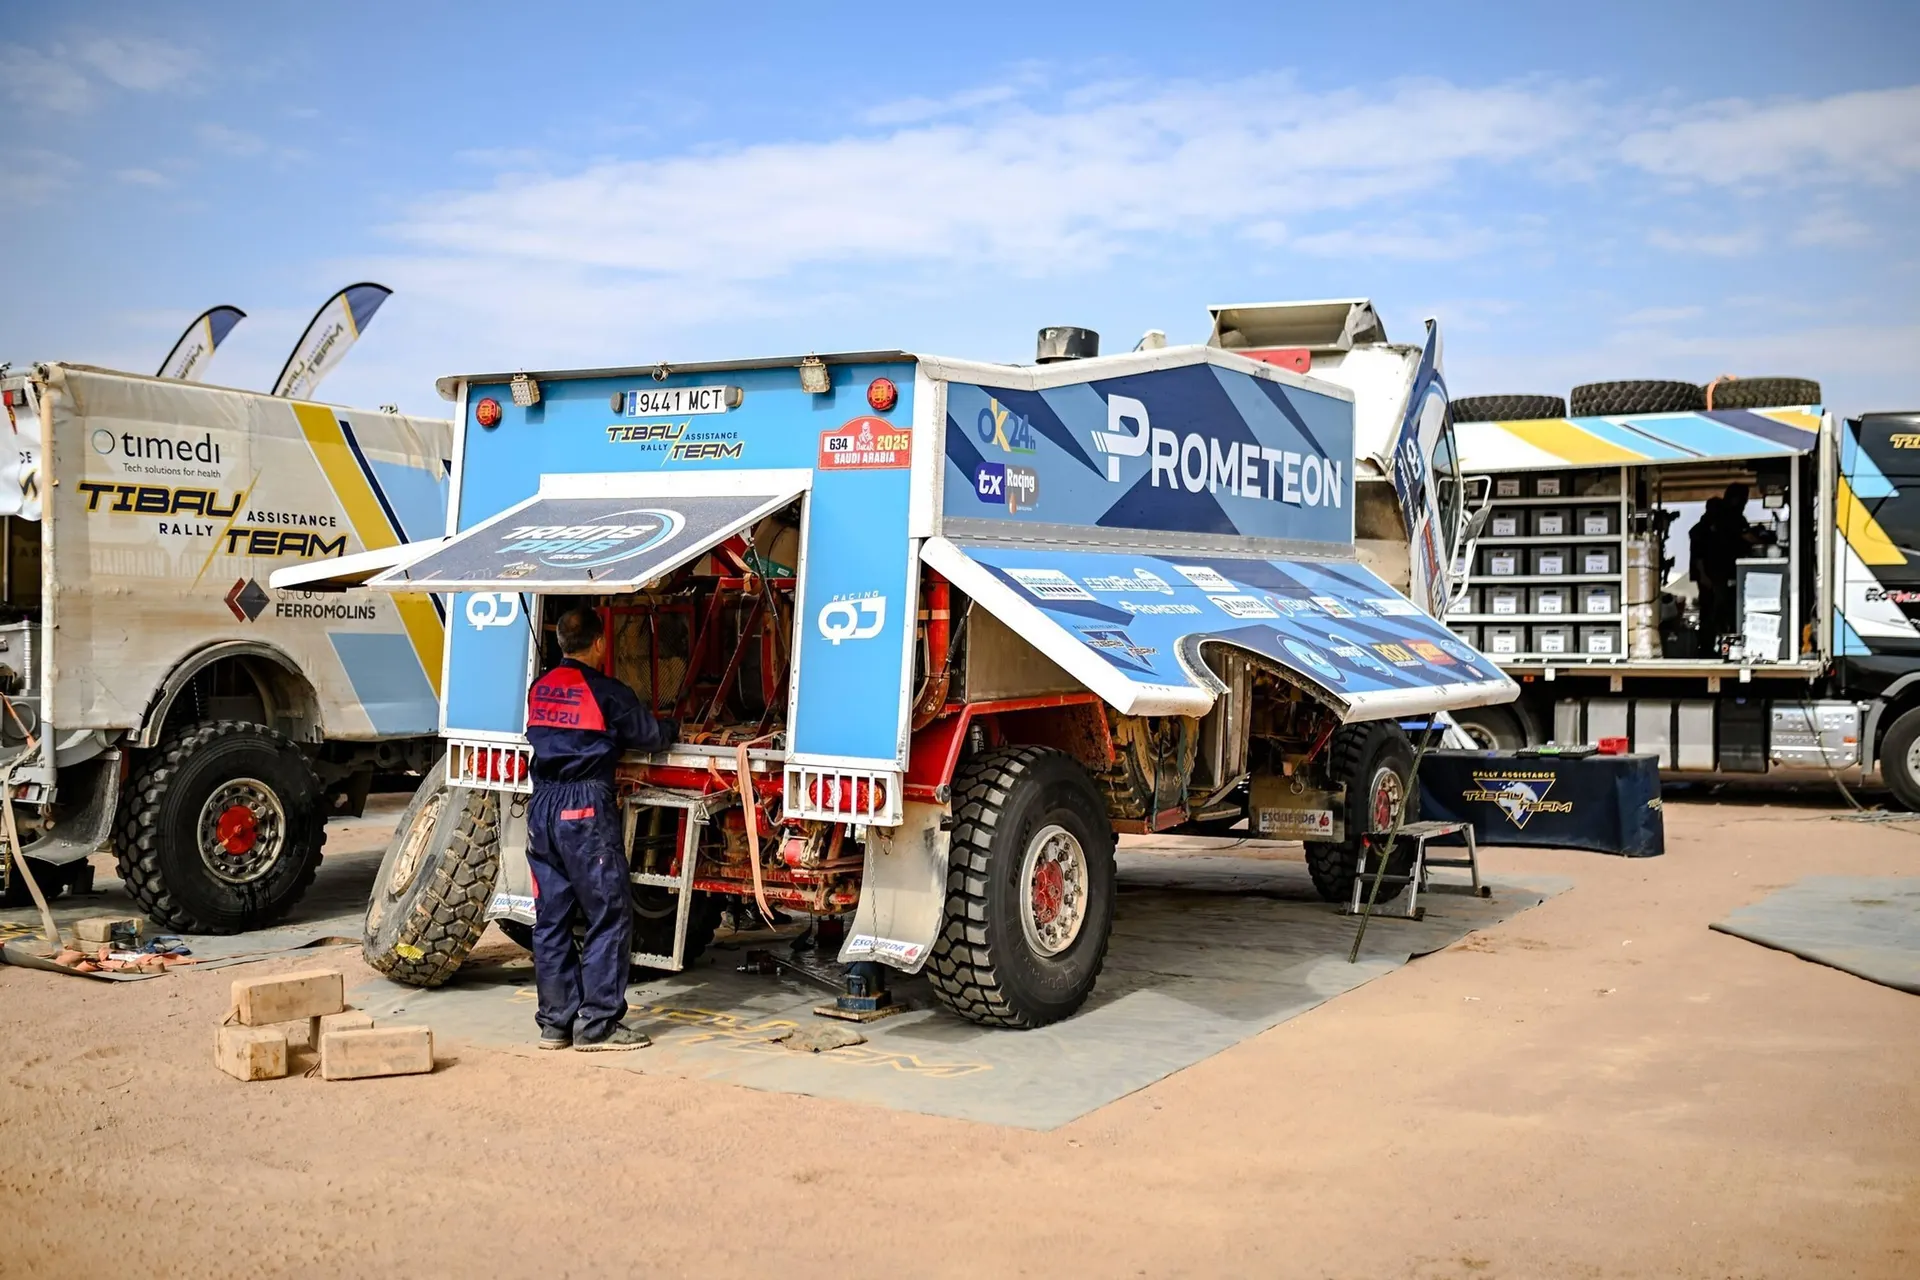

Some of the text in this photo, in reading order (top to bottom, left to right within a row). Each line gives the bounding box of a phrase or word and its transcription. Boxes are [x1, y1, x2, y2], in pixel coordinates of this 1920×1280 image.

[307, 322, 344, 374] TEAM
[638, 390, 681, 413] 9441
[688, 389, 722, 410] MCT
[607, 424, 685, 441] TIBAU
[685, 432, 738, 441] ASSISTANCE
[120, 432, 221, 464] timedi
[640, 443, 669, 452] RALLY
[672, 442, 743, 459] TEAM
[829, 438, 848, 451] 634
[876, 434, 909, 451] 2025
[833, 451, 896, 464] SAUDI ARABIA
[1091, 393, 1342, 509] PROMETEON
[122, 462, 221, 478] Tech solutions for health
[978, 469, 1003, 495] tx
[1006, 468, 1035, 502] Racing
[78, 482, 243, 518] TIBAU
[247, 511, 337, 527] ASSISTANCE
[159, 522, 214, 537] RALLY
[226, 528, 348, 558] TEAM
[276, 587, 325, 601] GRUO
[832, 590, 880, 602] RACING
[275, 603, 376, 619] FERROMOLINS
[1118, 600, 1203, 615] PROMETEON
[535, 685, 583, 698] DAF
[532, 709, 580, 725] ISUZU
[1519, 801, 1573, 813] TEAM
